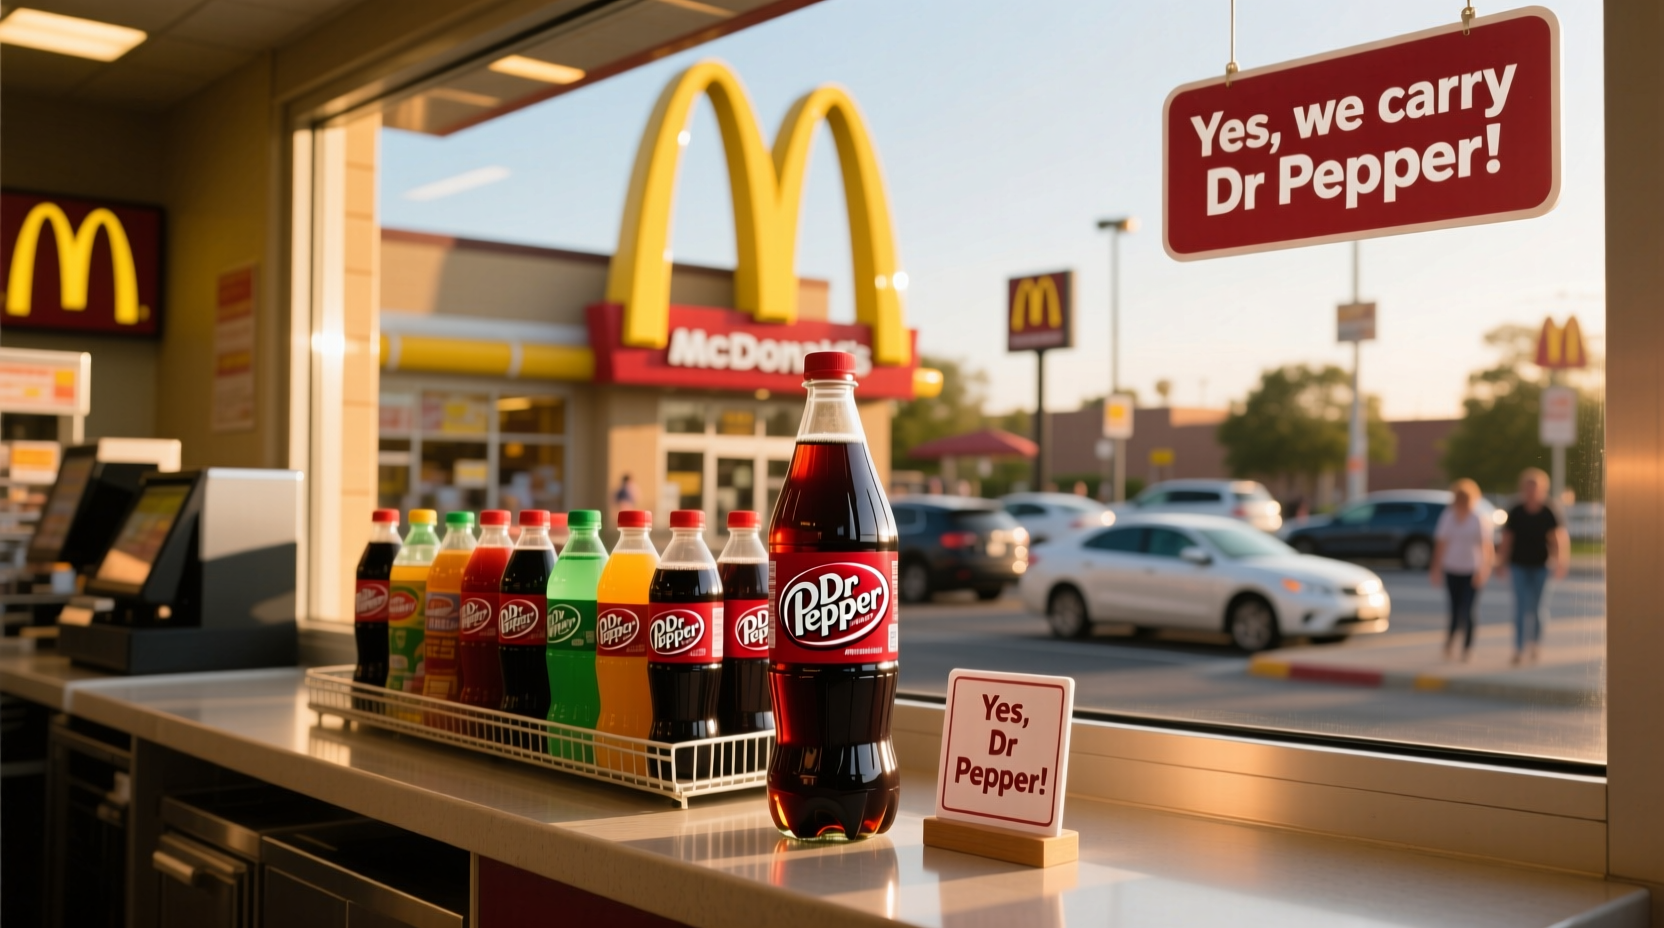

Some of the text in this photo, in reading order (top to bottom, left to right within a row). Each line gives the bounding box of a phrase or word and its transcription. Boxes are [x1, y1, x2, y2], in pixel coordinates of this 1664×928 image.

[1190, 63, 1518, 158] Yes, we carry
[1206, 123, 1501, 216] Dr Pepper!
[819, 572, 859, 605] Dr
[607, 613, 622, 629] Dr
[666, 614, 684, 632] Dr
[757, 610, 769, 628] D
[784, 581, 883, 637] Pepper
[738, 615, 769, 645] Pep
[982, 693, 1029, 729] Yes,
[988, 729, 1018, 757] Dr
[955, 756, 1048, 797] Pepper!
